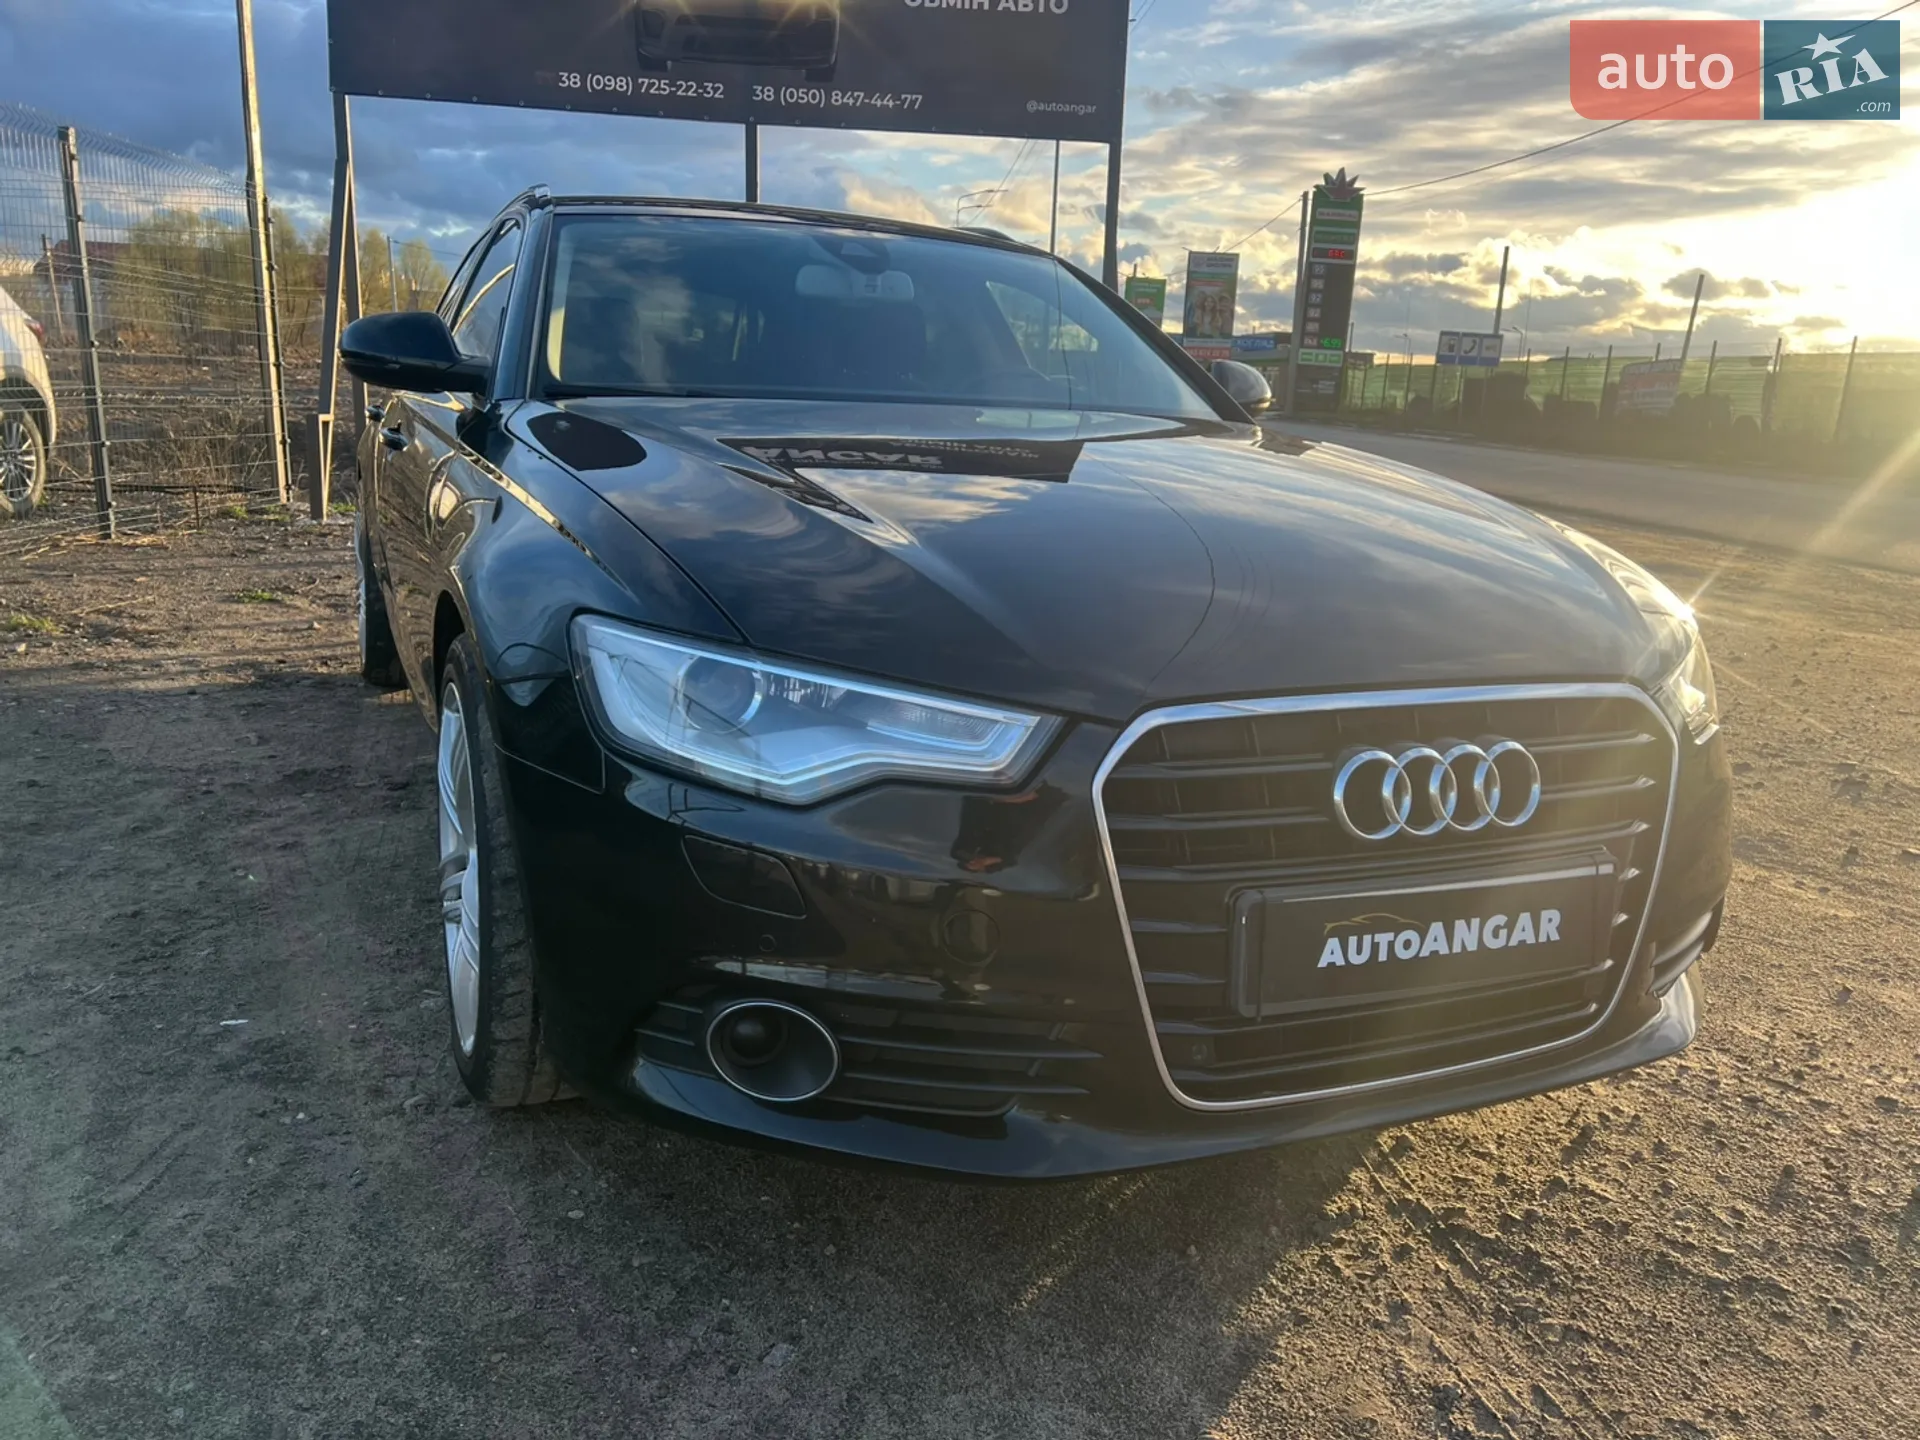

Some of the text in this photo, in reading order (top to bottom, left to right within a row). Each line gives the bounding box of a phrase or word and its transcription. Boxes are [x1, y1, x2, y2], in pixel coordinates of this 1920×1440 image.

[558, 72, 725, 99] 38 (098) 725-22-32
[752, 85, 923, 109] 38 (050) 847-44-77
[1026, 100, 1097, 116] @autoangar
[1317, 909, 1561, 968] AUTOANGAR
